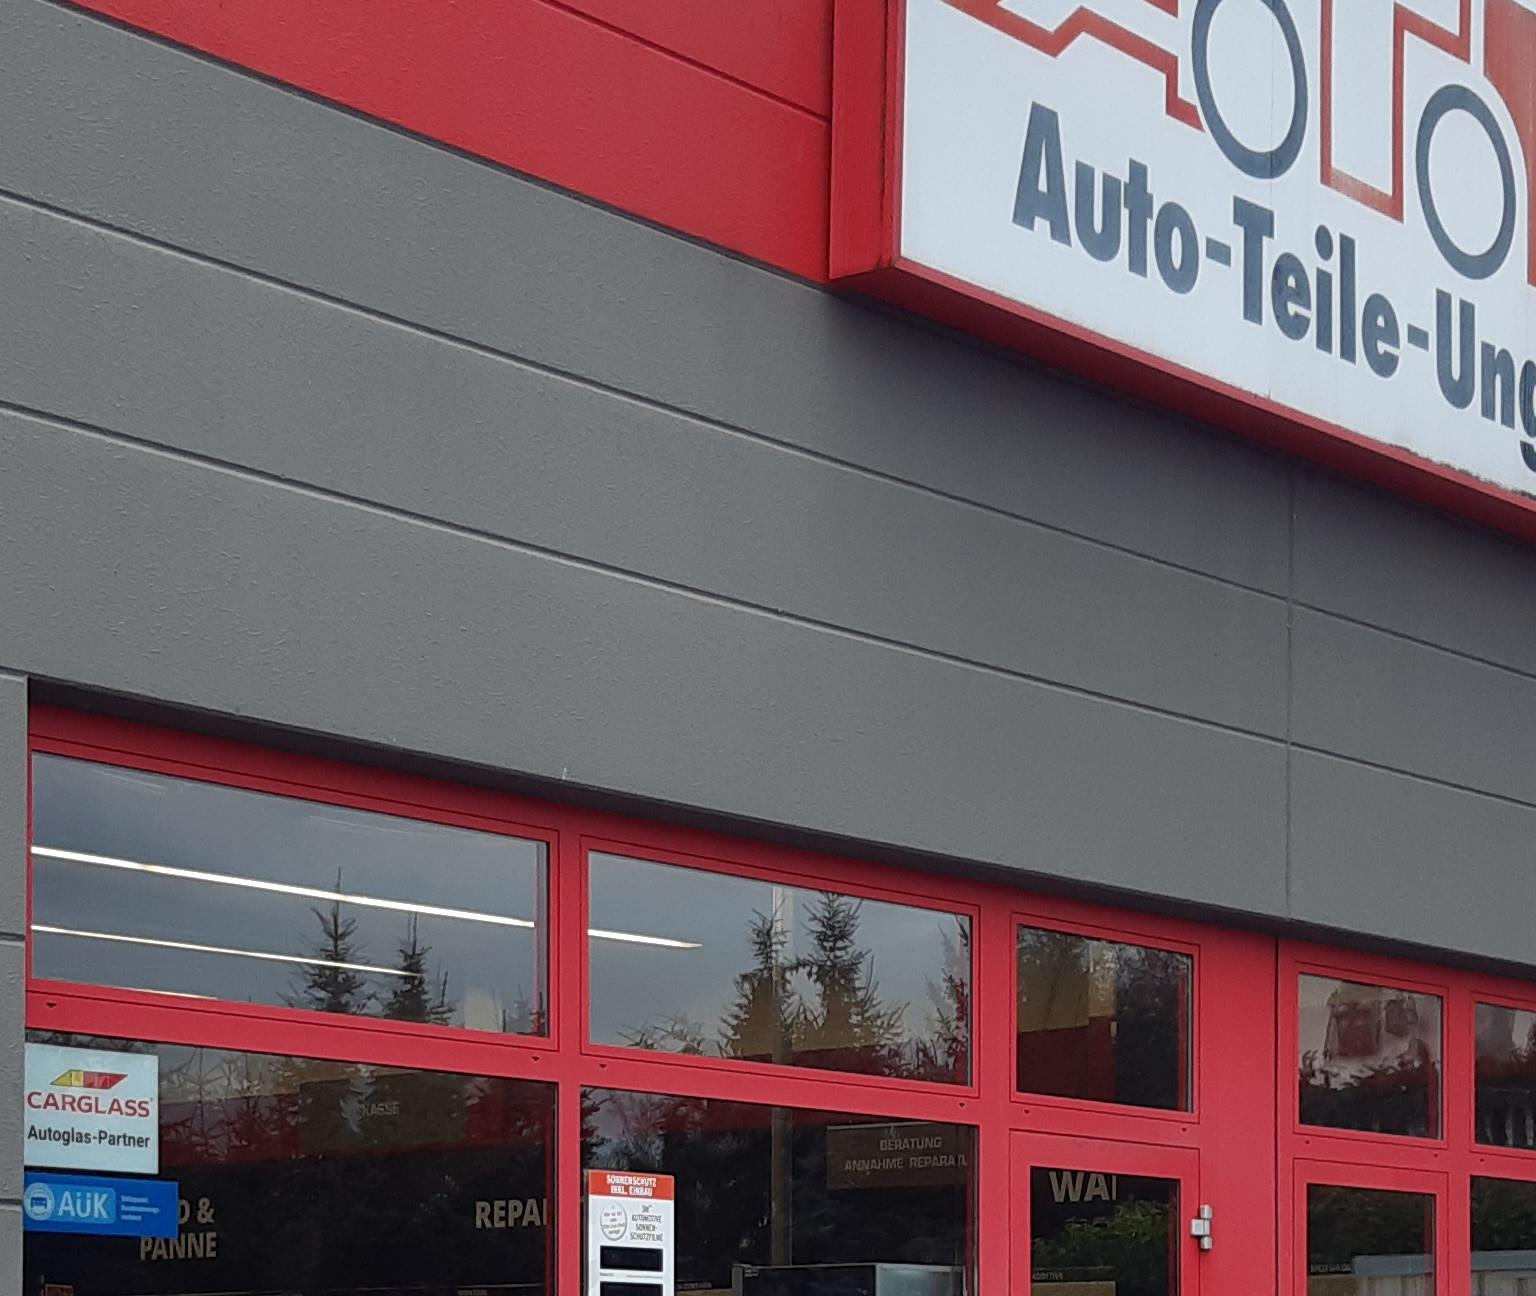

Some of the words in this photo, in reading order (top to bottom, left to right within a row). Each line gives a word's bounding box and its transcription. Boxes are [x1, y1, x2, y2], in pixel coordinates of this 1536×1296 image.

[27, 1091, 150, 1118] CARGLASS
[27, 1125, 151, 1148] Autoglas-Partner
[879, 1136, 943, 1152] BERATUNG
[844, 1157, 904, 1171] ANNAHME
[1049, 1171, 1118, 1202] WA
[196, 1197, 215, 1224] &
[475, 1198, 547, 1229] REPA
[139, 1231, 217, 1262] PANNE
